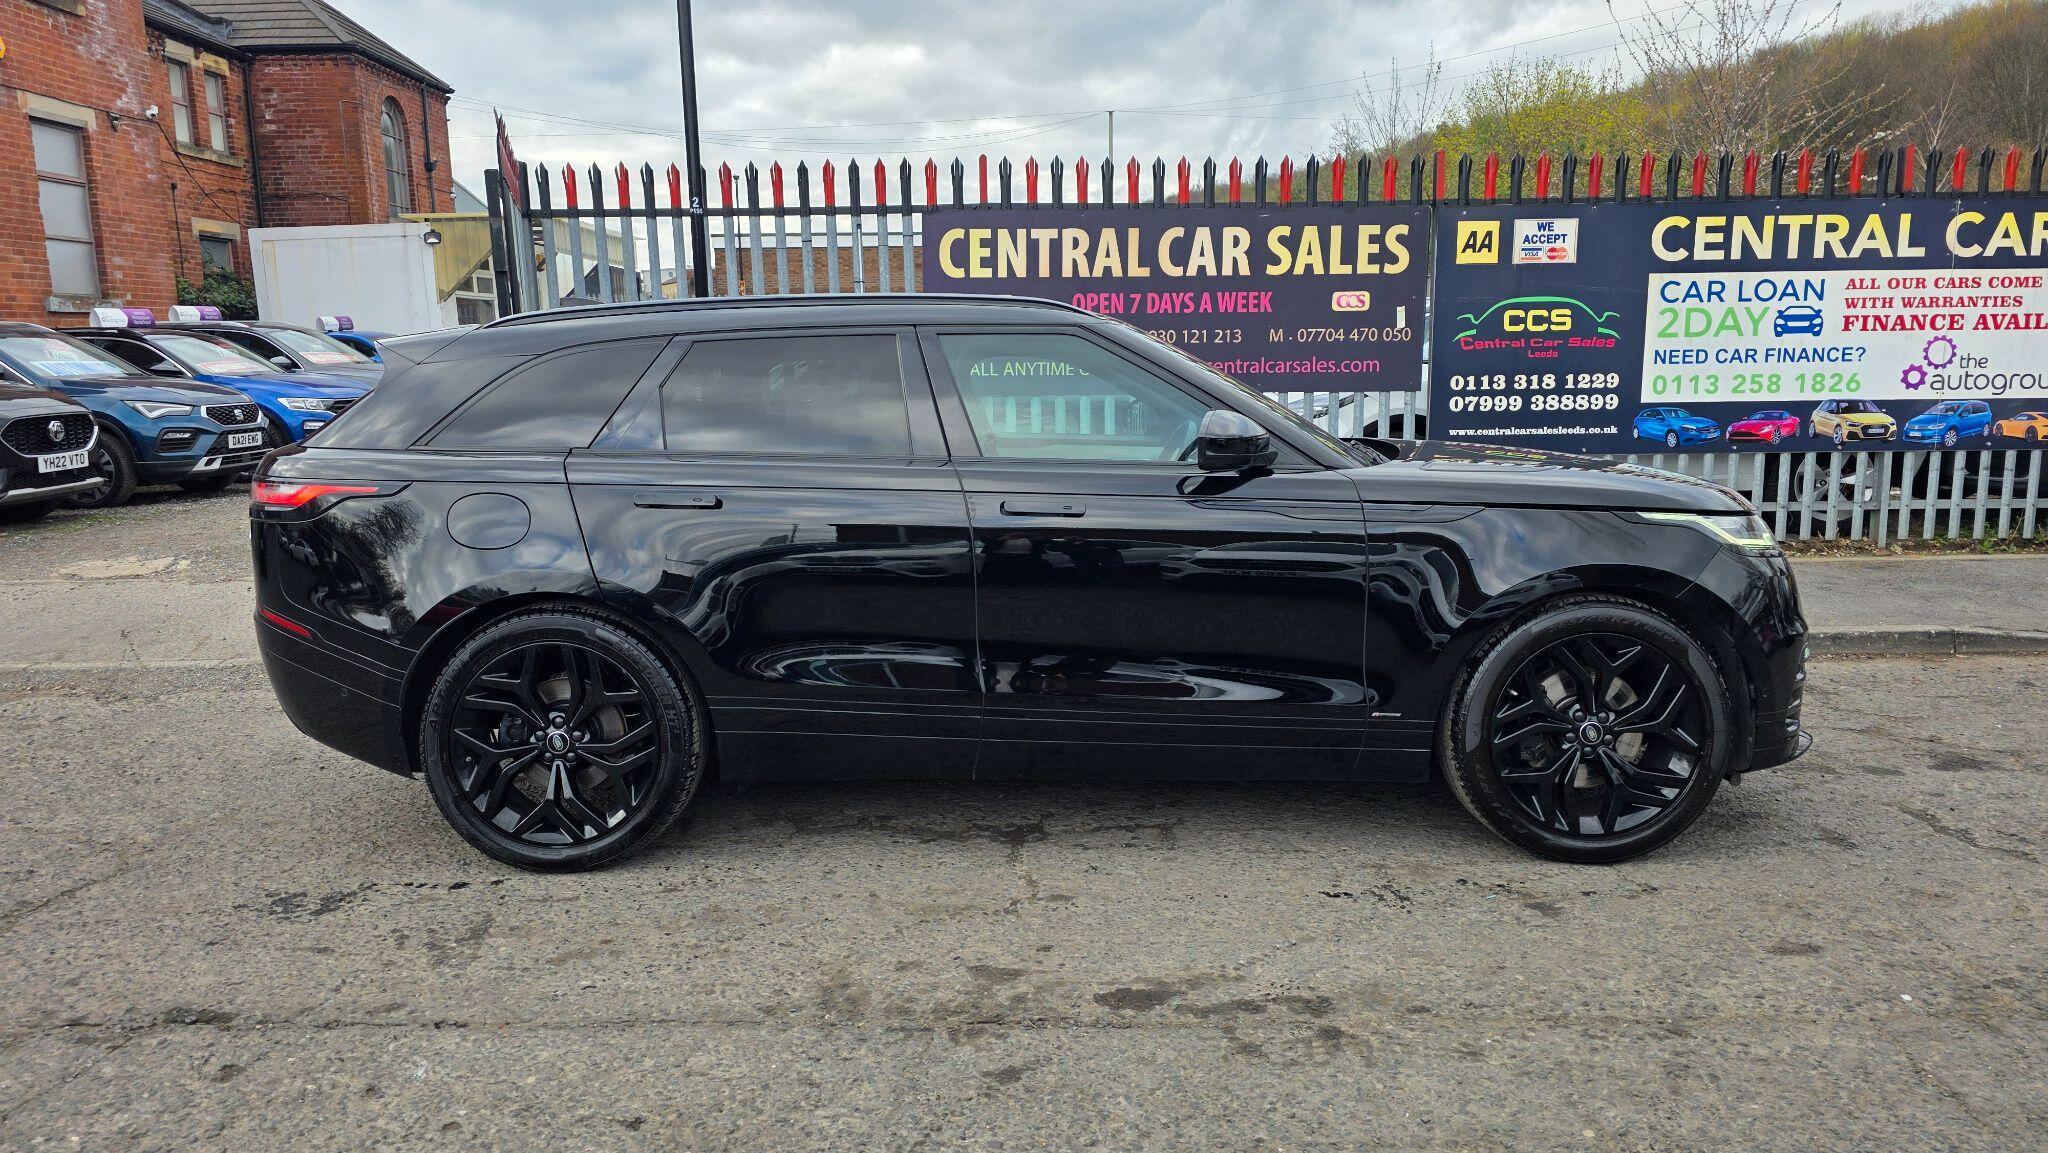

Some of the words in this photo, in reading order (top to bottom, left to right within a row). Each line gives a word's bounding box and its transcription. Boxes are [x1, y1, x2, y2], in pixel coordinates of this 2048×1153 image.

[692, 197, 699, 207] 2
[1537, 221, 1555, 232] WE
[1461, 230, 1493, 254] AA
[1522, 233, 1568, 244] ACCEPT
[1651, 213, 1926, 262] CENTRAL
[938, 227, 1151, 279] CENTRAL
[1157, 226, 1252, 276] CAR
[1265, 224, 1411, 276] SALES
[1659, 280, 1726, 304] CAR
[1737, 278, 1826, 302] LOAN
[1845, 278, 1881, 290] ALL
[1887, 277, 1927, 290] OUR
[1933, 277, 1982, 289] CARS
[1988, 276, 2043, 289] COME
[1072, 292, 1124, 314] OPEN
[1129, 293, 1142, 314] 7
[1146, 292, 1195, 314] DAYS
[1200, 292, 1213, 313] A
[1217, 291, 1273, 313] WEEK
[1844, 297, 1895, 309] WITH
[1901, 295, 2024, 308] WARRANTIES
[1503, 308, 1572, 332] CCS
[1656, 306, 1771, 339] 2DAY
[1841, 314, 1966, 332] FINANCE
[1972, 312, 2048, 331] AVAIL
[1182, 329, 1207, 343] 121
[1214, 329, 1242, 343] 213
[1297, 329, 1345, 342] 07704
[1350, 328, 1378, 342] 470
[1382, 328, 1411, 342] 050
[1460, 336, 1525, 350] Central
[1529, 338, 1563, 348] Car
[1567, 337, 1616, 348] Sales
[1527, 349, 1558, 358] Leeds
[1653, 349, 1708, 365] NEED
[1715, 348, 1758, 364] CAR
[1764, 347, 1866, 363] FINANCE?
[1959, 353, 1989, 369] the
[1207, 356, 1380, 374] entralcarsales.com
[1450, 375, 1506, 390] 0113
[1514, 373, 1556, 389] 318
[1564, 372, 1620, 389] 1229
[1652, 374, 1720, 395] 0113
[1731, 373, 1782, 394] 258
[1795, 372, 1862, 393] 1826
[1449, 395, 1523, 412] 07999
[1530, 393, 1619, 412] 388899
[1449, 426, 1618, 436] www.centralcarsalesleeds.co.uk
[43, 457, 67, 470] YH22
[69, 453, 85, 468] VTO
